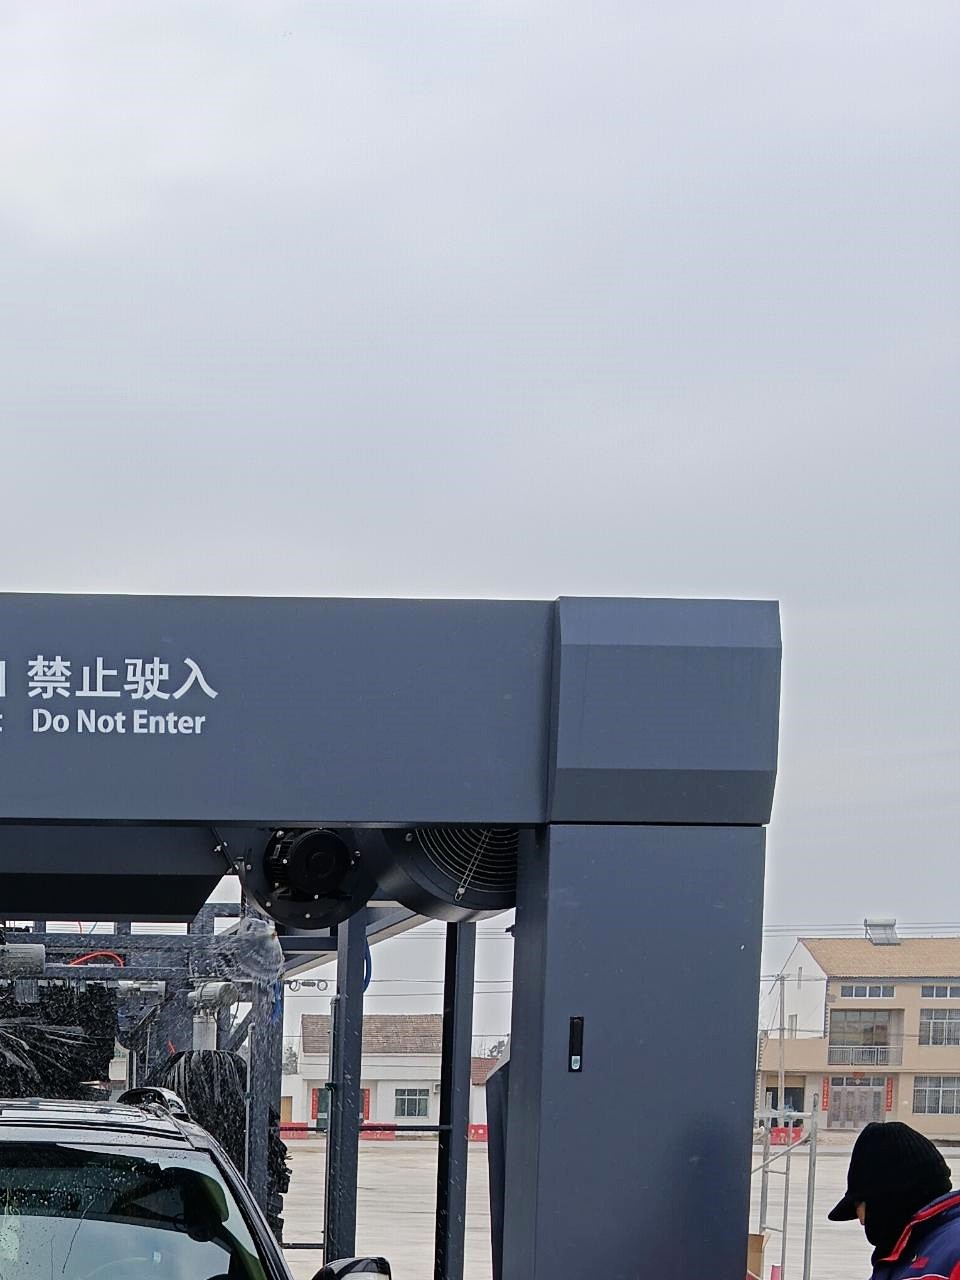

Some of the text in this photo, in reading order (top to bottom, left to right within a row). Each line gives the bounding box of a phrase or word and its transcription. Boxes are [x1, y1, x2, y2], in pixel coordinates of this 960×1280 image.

[27, 655, 218, 700] 禁止驶入
[32, 708, 70, 733] Do
[76, 709, 126, 734] Not
[133, 709, 206, 734] Enter
